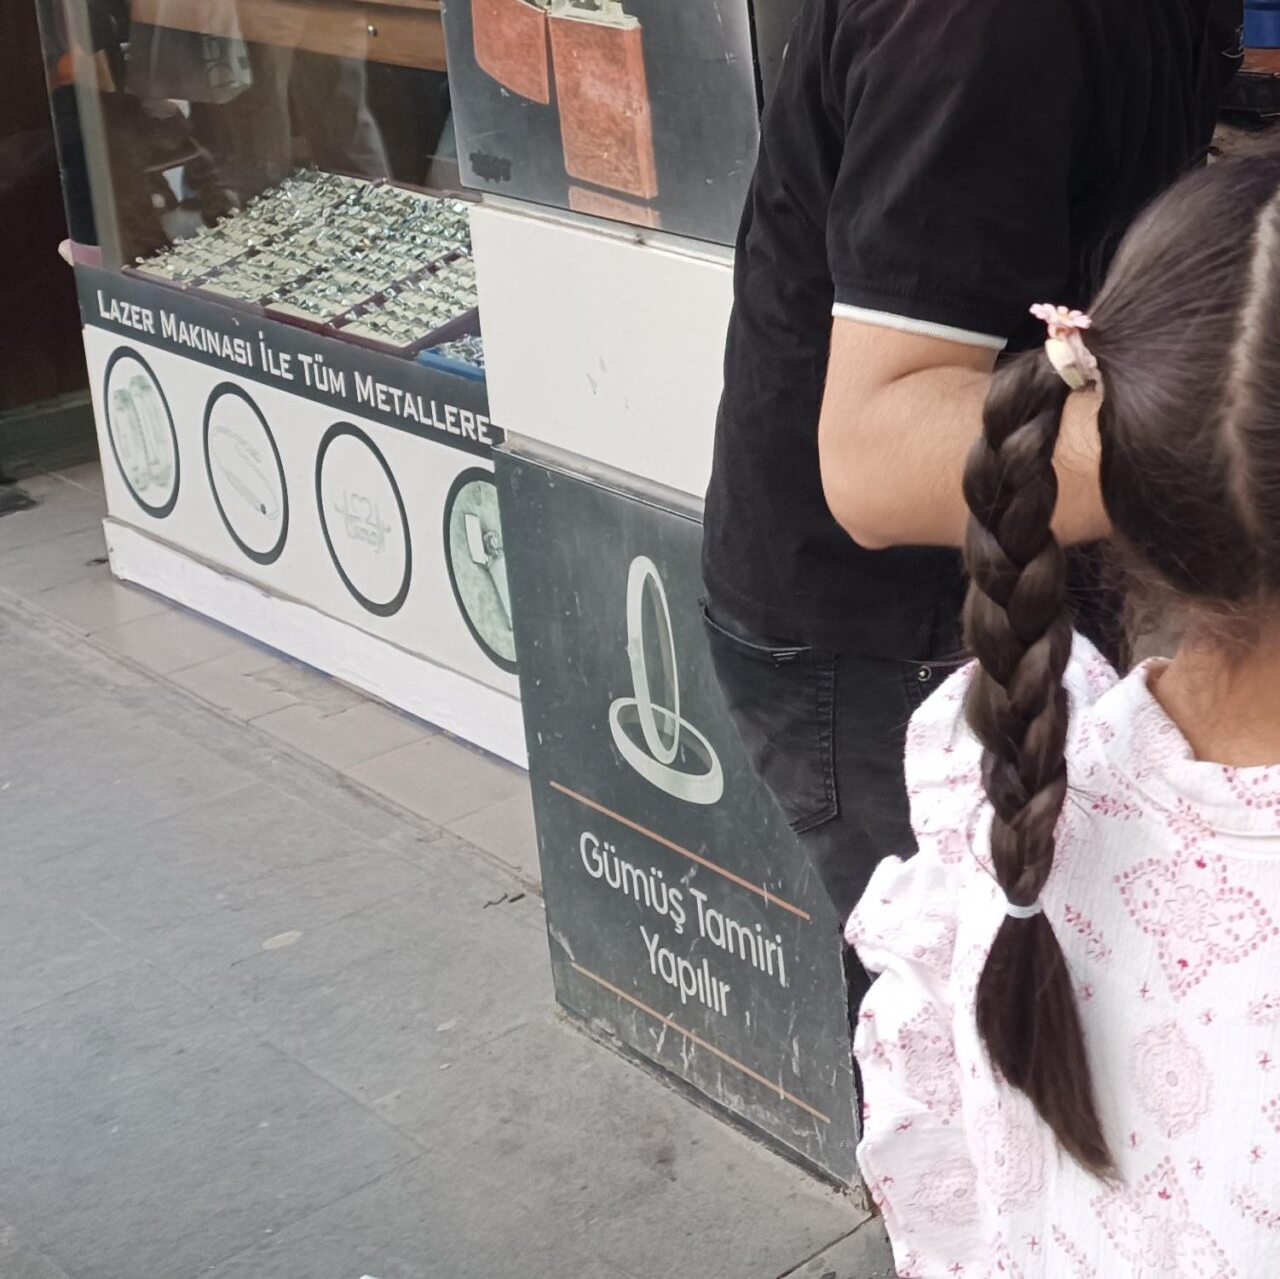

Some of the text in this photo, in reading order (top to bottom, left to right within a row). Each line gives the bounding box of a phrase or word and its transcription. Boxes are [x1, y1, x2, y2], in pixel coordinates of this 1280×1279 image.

[579, 830, 786, 988] Gümüş Tamiri
[640, 926, 731, 1017] Yapılır
